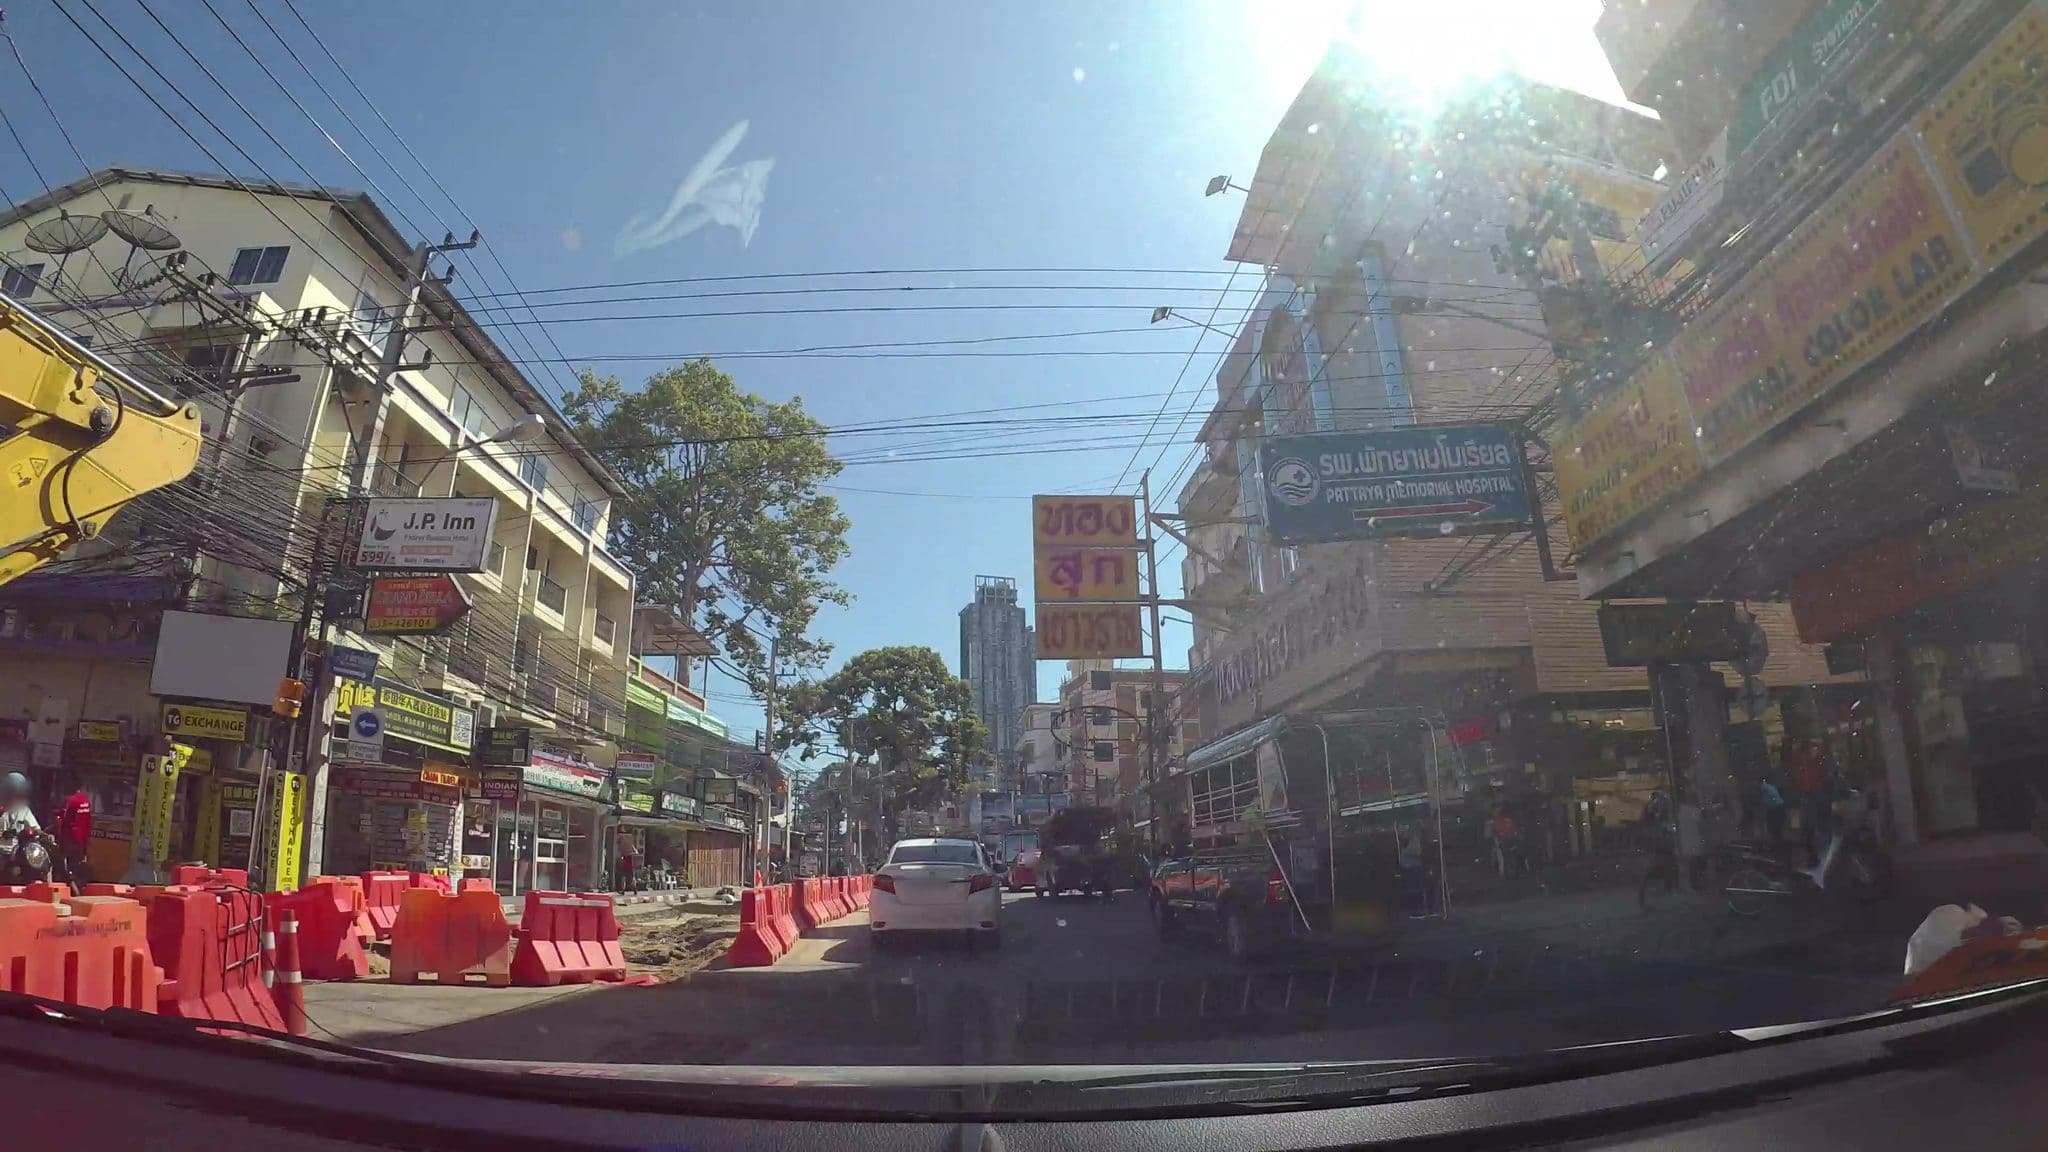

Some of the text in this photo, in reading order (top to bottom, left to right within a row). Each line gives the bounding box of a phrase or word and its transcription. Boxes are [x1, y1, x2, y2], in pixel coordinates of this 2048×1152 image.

[1803, 285, 1893, 367] COLOR
[1891, 234, 1951, 297] LAB
[1327, 476, 1515, 503] PATTAYA MEMORIAL HOSPITAL
[403, 512, 476, 530] J.P. Inn
[167, 714, 245, 732] TG EXCHANGE
[484, 781, 518, 791] INDIAN
[270, 788, 281, 869] EXCHANGE
[286, 796, 298, 876] EXCHANGE
